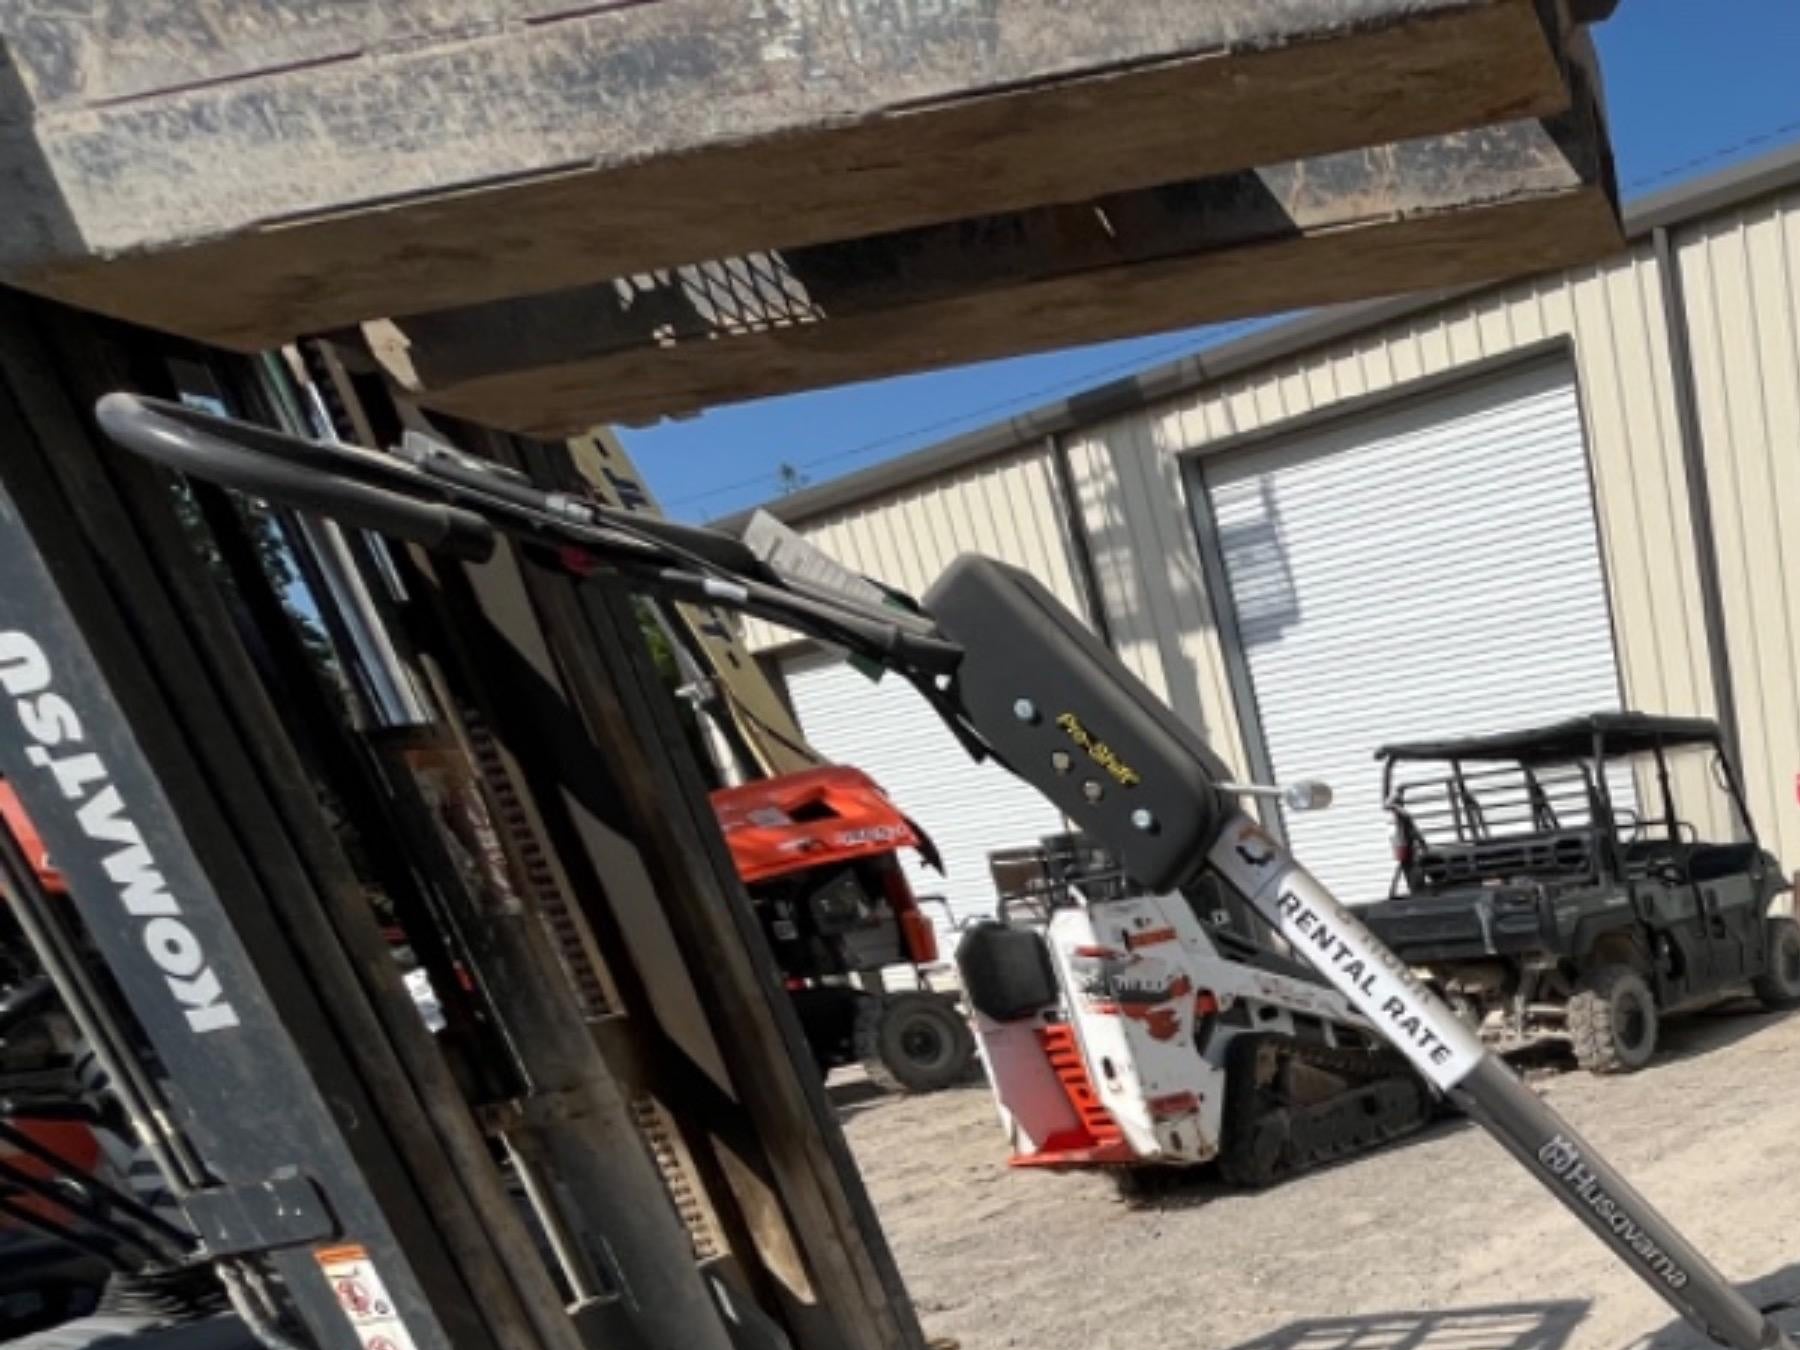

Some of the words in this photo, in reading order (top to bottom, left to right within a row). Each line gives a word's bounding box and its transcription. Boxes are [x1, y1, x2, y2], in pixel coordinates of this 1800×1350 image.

[0, 630, 241, 1034] KOMATSU
[1277, 889, 1379, 998] RENTAL
[1381, 995, 1453, 1066] RATE
[1564, 1161, 1689, 1289] Husqvarna
